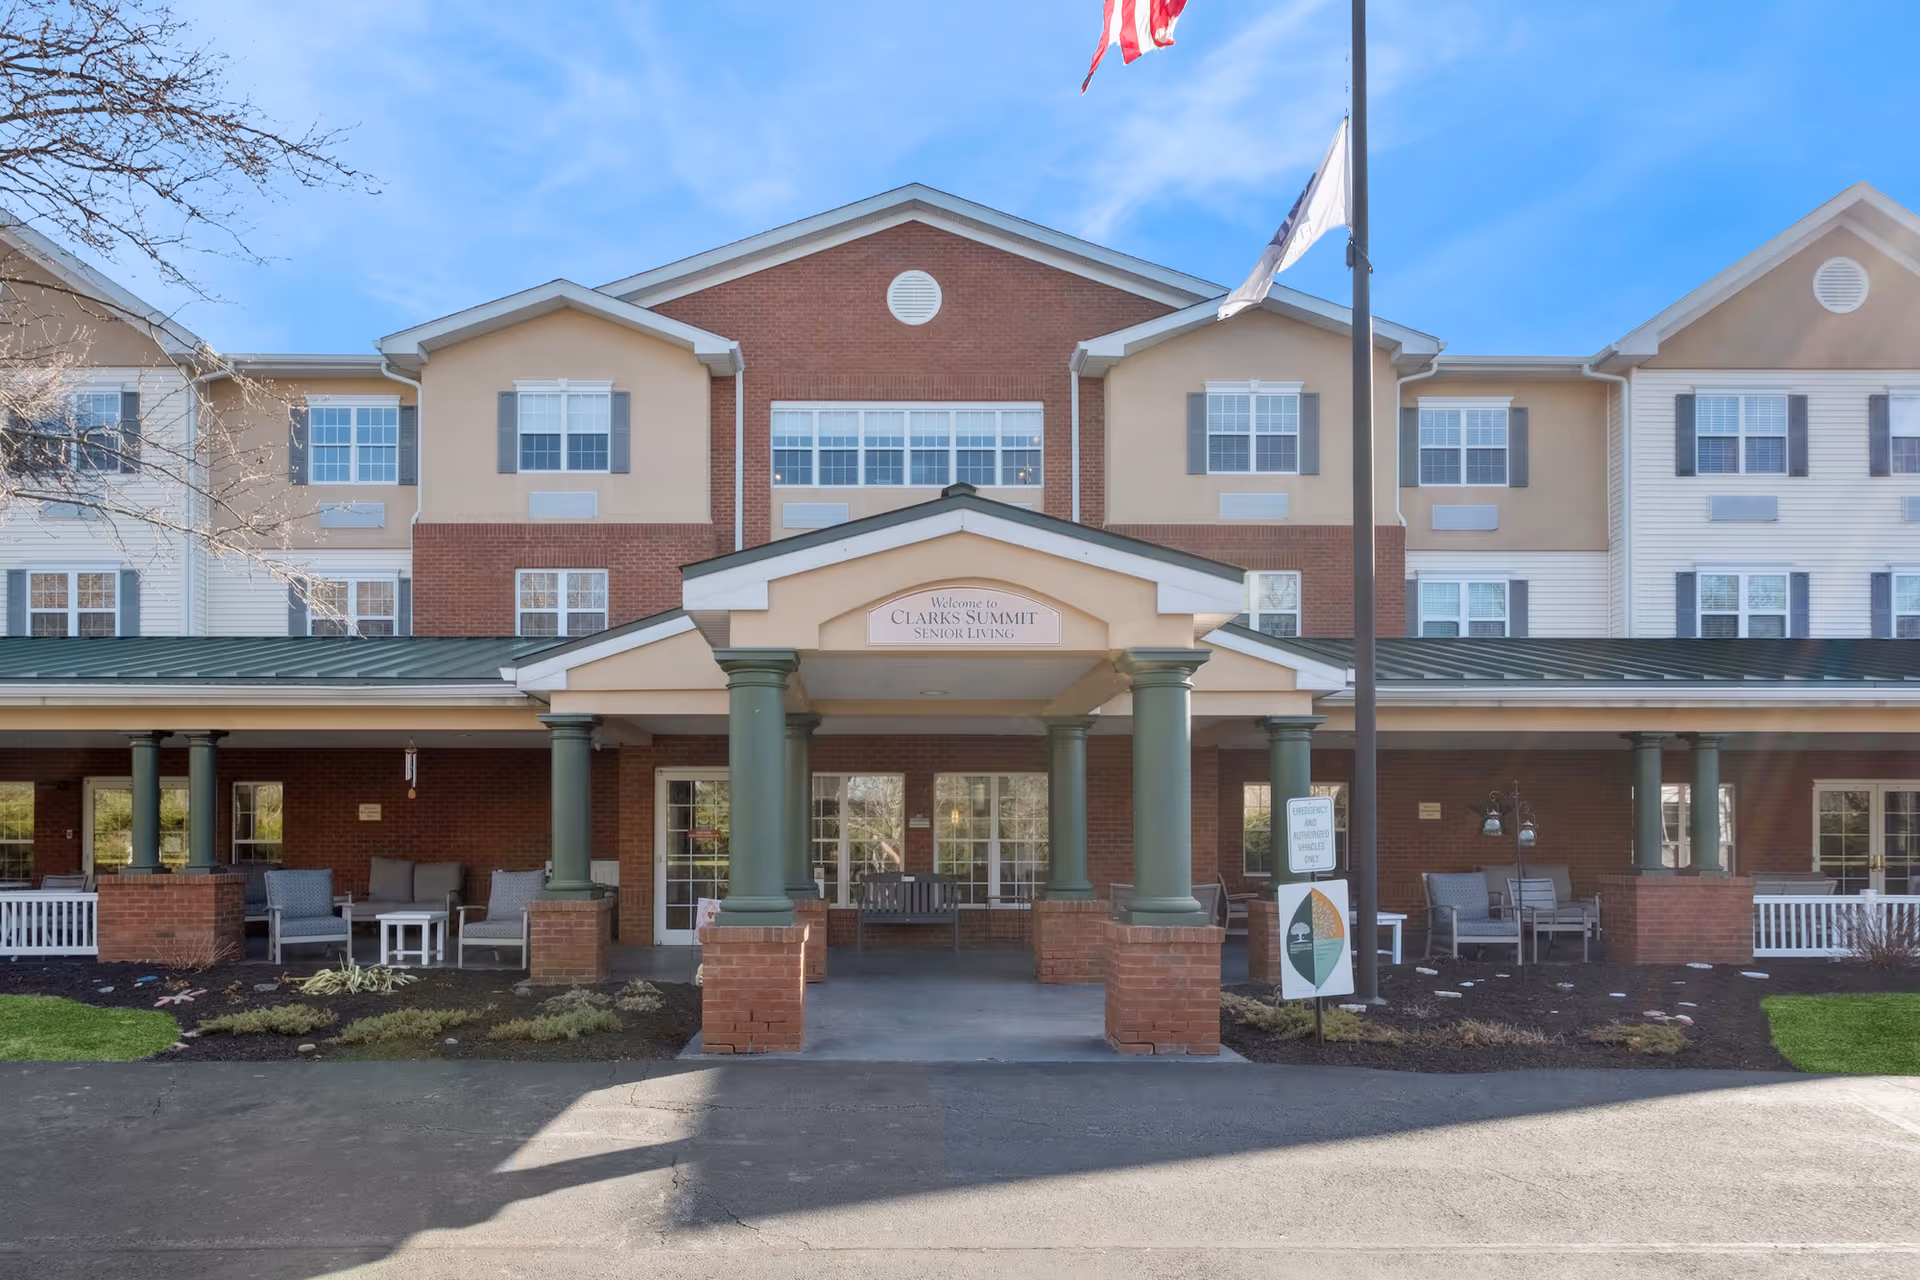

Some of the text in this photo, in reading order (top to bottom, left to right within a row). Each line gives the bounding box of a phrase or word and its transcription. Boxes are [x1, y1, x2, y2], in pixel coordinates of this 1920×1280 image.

[931, 597, 998, 608] Welcome to
[891, 609, 1038, 625] CLARKS SUMMIT
[914, 627, 1015, 639] SENIOR LIVING
[1292, 806, 1328, 816] EMERGENCY
[1304, 818, 1317, 827] AND
[1293, 830, 1329, 840] AUTHORIZED
[1298, 842, 1325, 851] VEHICLES
[1304, 855, 1320, 864] ONLY
